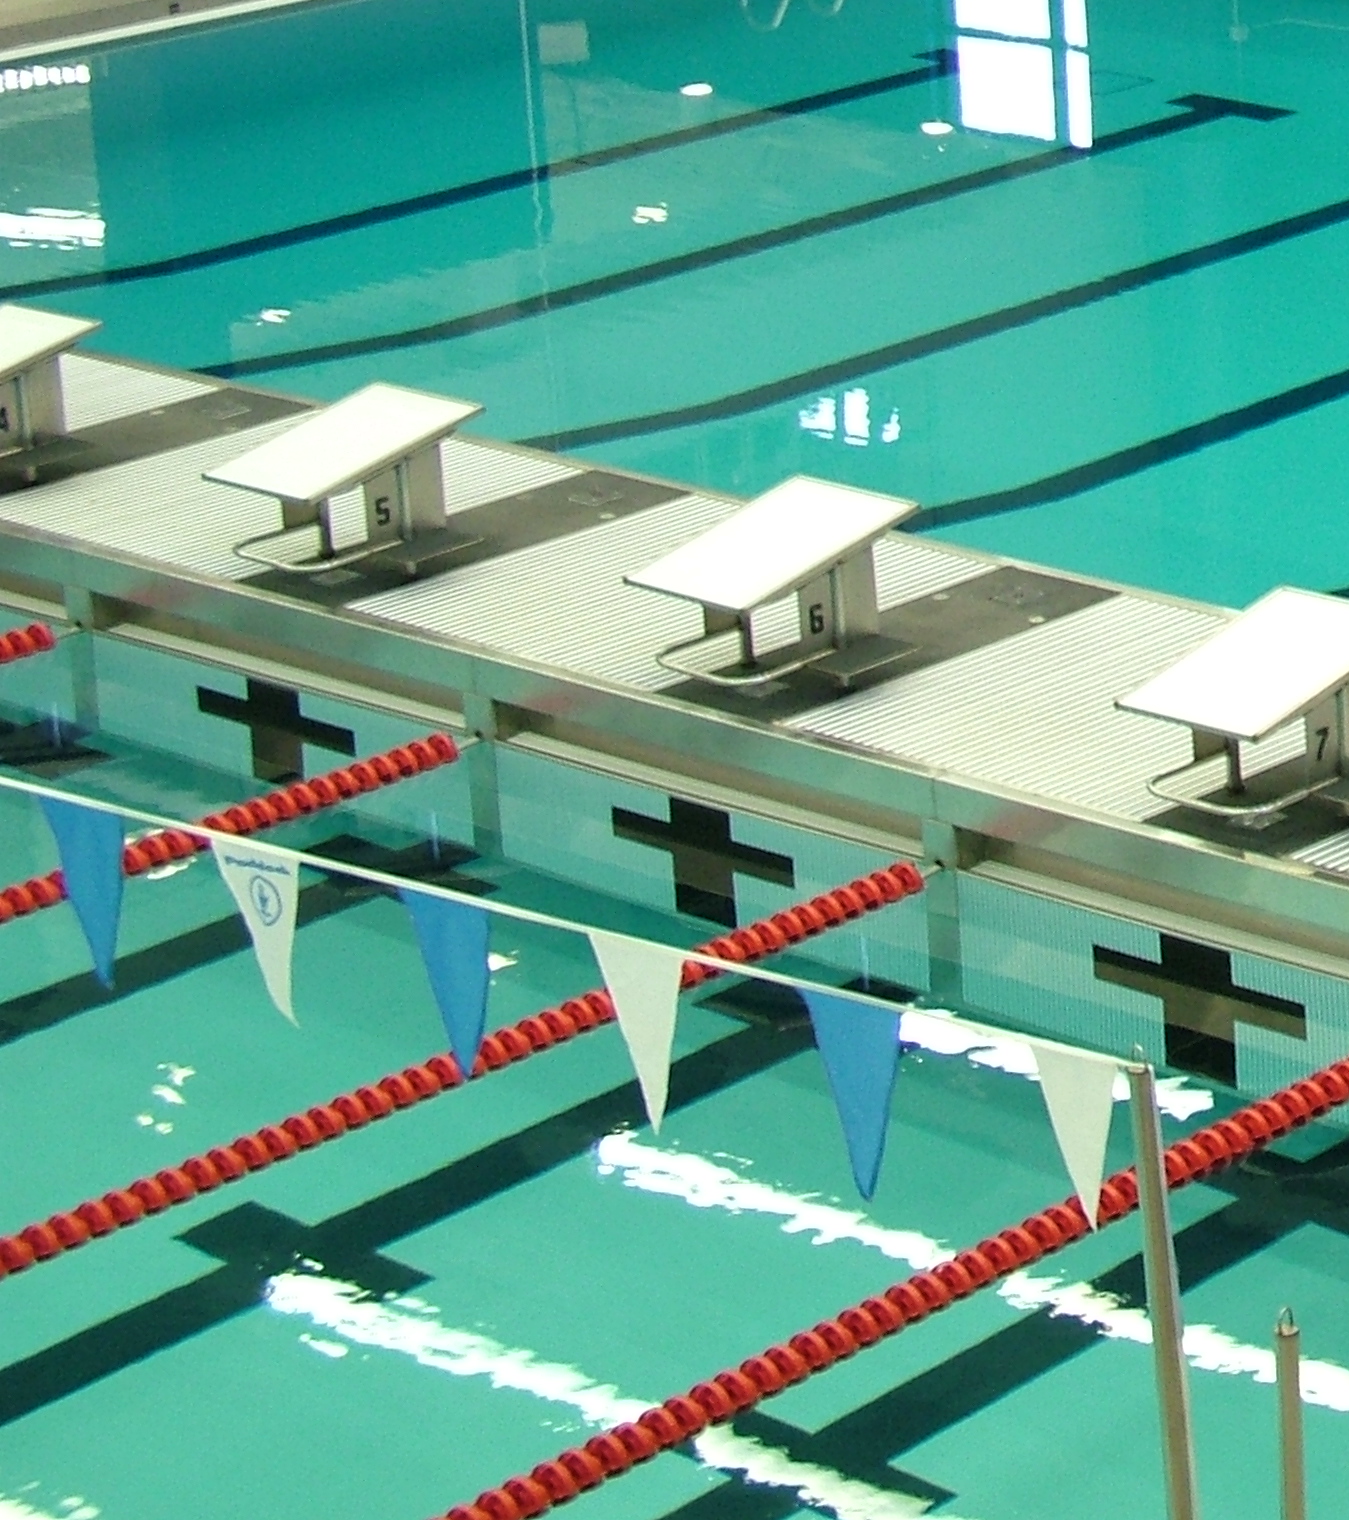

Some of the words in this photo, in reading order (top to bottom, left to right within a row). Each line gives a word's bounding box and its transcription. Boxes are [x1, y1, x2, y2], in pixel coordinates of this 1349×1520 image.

[375, 496, 390, 526] 5
[809, 602, 824, 635] 6
[1316, 726, 1329, 761] 7
